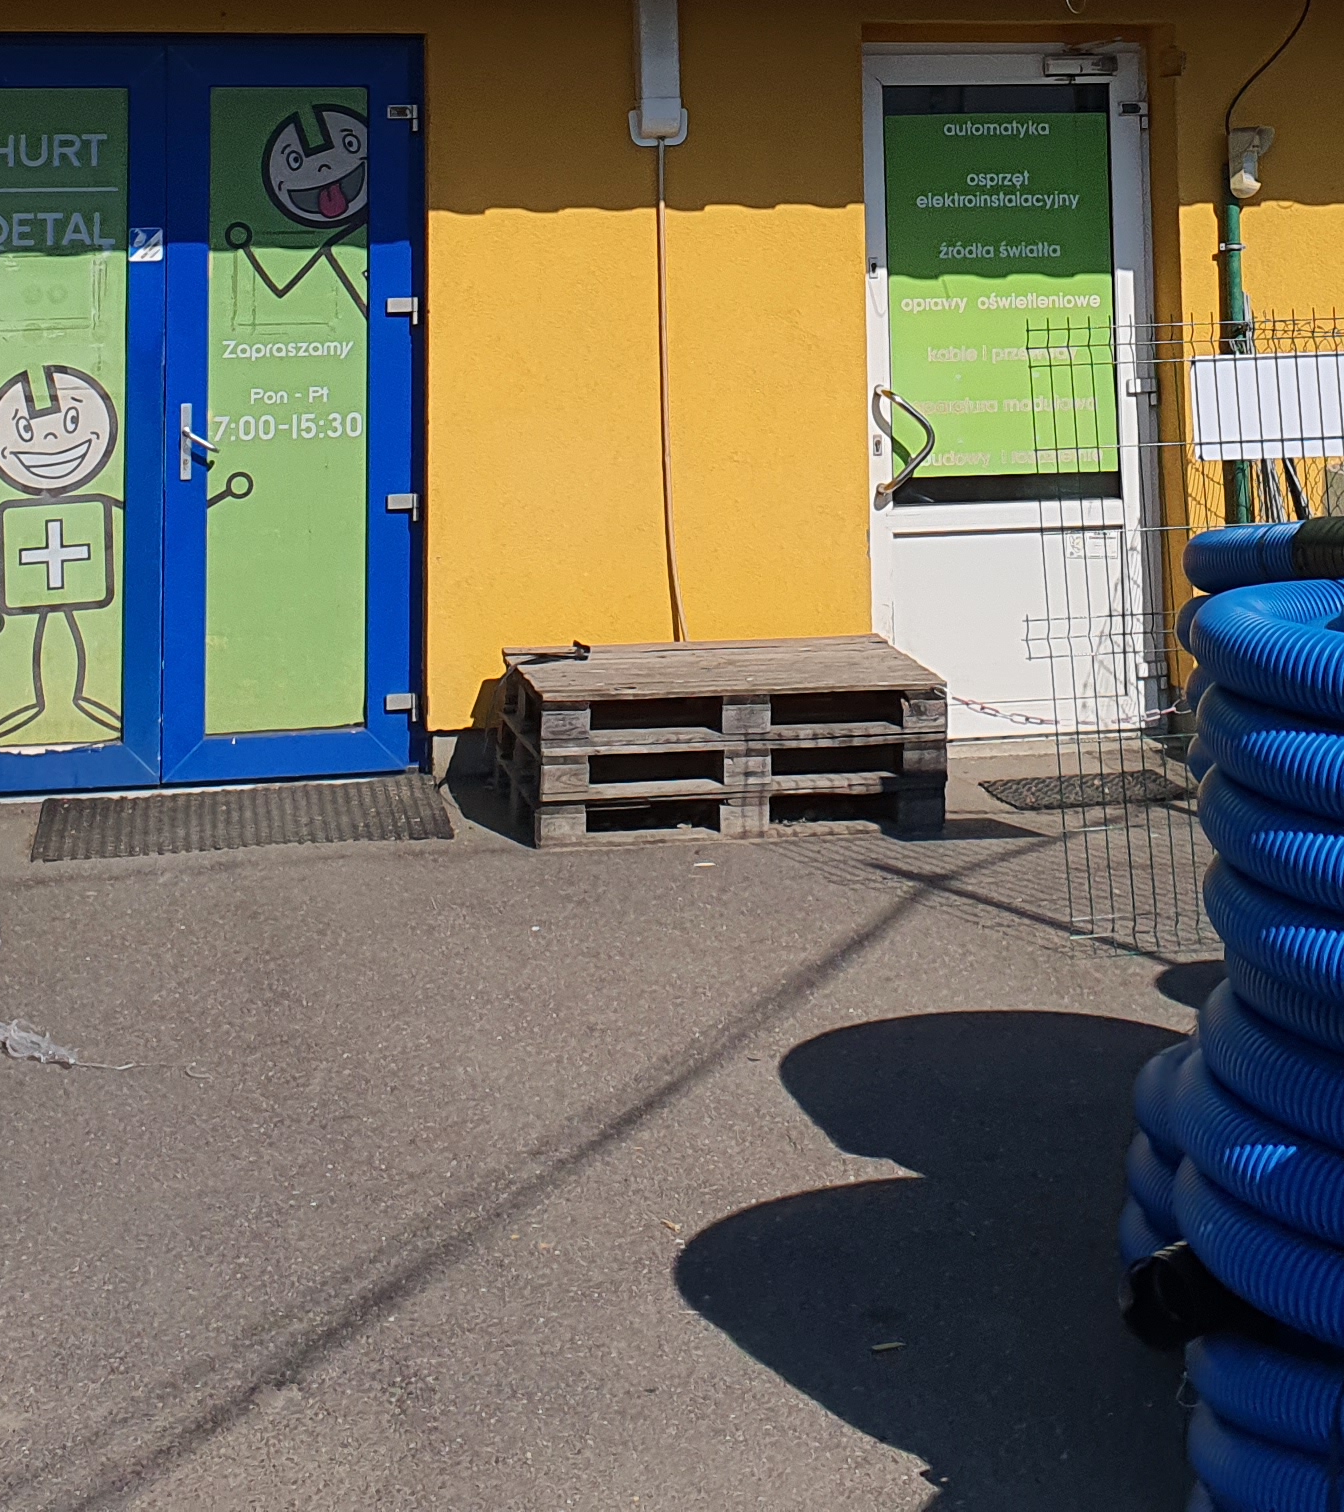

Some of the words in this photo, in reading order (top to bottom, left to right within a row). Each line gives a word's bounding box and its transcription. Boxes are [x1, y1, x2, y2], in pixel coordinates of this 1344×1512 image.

[943, 119, 1050, 138] automatyka
[967, 170, 1030, 188] osprzęt
[916, 191, 1080, 209] elektroinstalacyjny
[939, 242, 994, 259] źródła
[999, 241, 1061, 258] światła
[901, 295, 968, 314] oprawy
[977, 292, 1101, 310] oświetleniowe
[222, 340, 354, 361] Zapraszamy
[250, 388, 288, 404] Pon
[308, 386, 329, 403] Pt
[213, 411, 362, 442] 7:00-15:30
